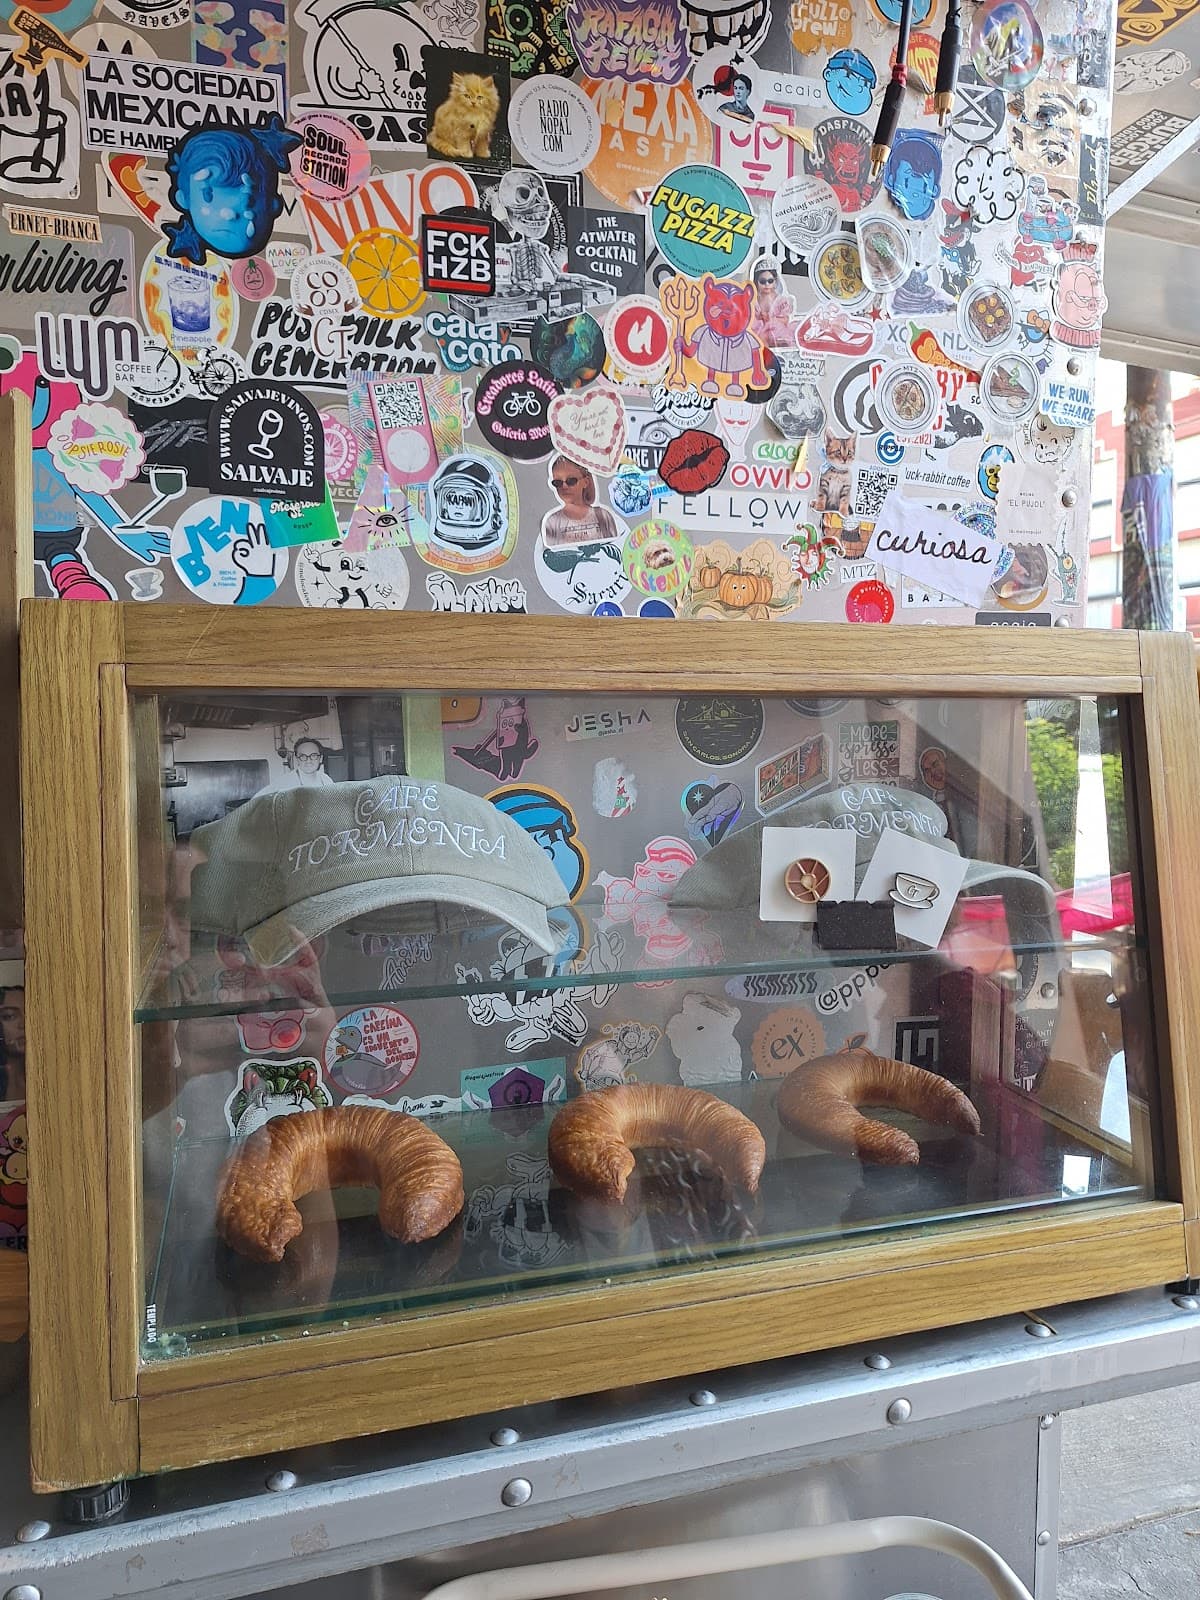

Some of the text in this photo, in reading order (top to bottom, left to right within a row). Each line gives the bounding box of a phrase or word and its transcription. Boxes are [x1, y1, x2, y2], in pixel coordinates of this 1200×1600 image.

[85, 61, 275, 103] LA SOCIEDAD
[773, 81, 822, 99] acaia
[87, 89, 275, 130] MEXICANA
[538, 98, 570, 118] RADIO
[89, 127, 116, 145] DE
[540, 116, 572, 136] NOPAL
[305, 126, 347, 157] SOUL
[542, 134, 564, 153] .COM
[303, 158, 346, 189] STATION
[808, 194, 833, 206] waves
[596, 216, 619, 228] THE
[426, 229, 490, 259] FCK
[579, 230, 637, 246] ATWATER
[660, 212, 735, 255] PIZZA
[268, 248, 306, 256] MANGO
[575, 245, 638, 266] COCKTAIL
[426, 252, 492, 282] HZB
[590, 261, 623, 278] CLUB
[114, 364, 152, 374] COFFEE
[114, 374, 135, 382] BAR
[476, 370, 525, 416] Creadores
[1048, 382, 1092, 406] WE RUN.
[1042, 398, 1060, 414] WE
[220, 388, 314, 466] WWW.SALVAJEVINOS.COM
[56, 434, 132, 460] OOPSIE ROSIE
[220, 462, 314, 488] SALVAJE
[904, 468, 971, 488] uck-rabbit coffee
[658, 497, 801, 520] FELLOW
[176, 500, 250, 588] BIEN
[876, 529, 992, 567] curiosa
[842, 563, 876, 580] MTZ
[682, 730, 694, 747] SAN
[354, 783, 440, 827] CAFÉ
[288, 816, 507, 874] TORMENTA
[362, 1010, 378, 1022] LA
